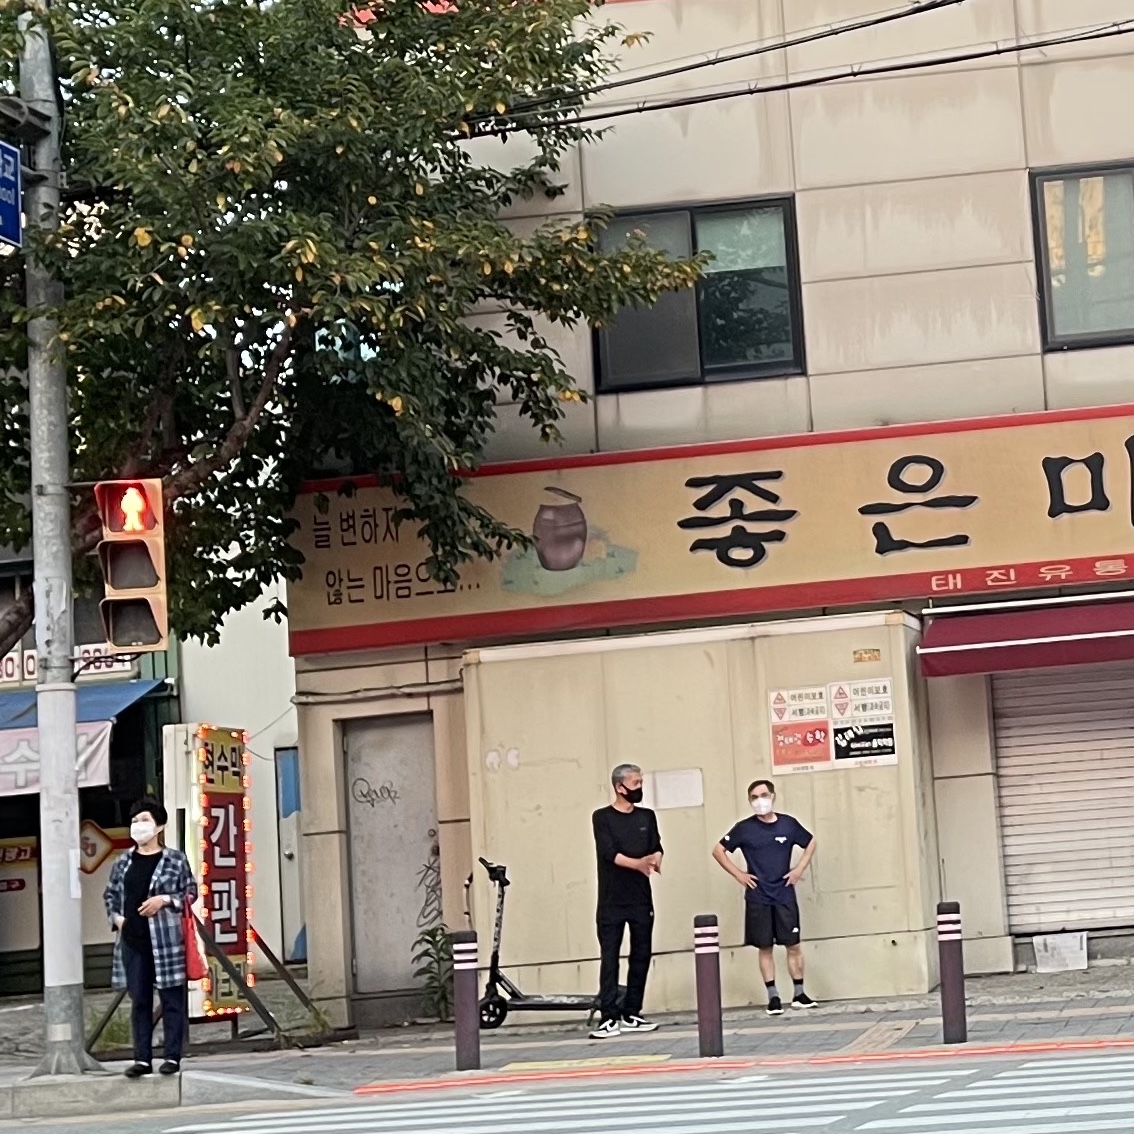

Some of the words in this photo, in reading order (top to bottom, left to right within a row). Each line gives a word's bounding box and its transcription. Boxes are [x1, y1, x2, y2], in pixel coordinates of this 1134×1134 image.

[0, 149, 16, 181] 교
[313, 512, 331, 548] 늘
[326, 568, 365, 605] 않는
[852, 684, 888, 697] 어린이보호
[210, 803, 240, 945] 간판
